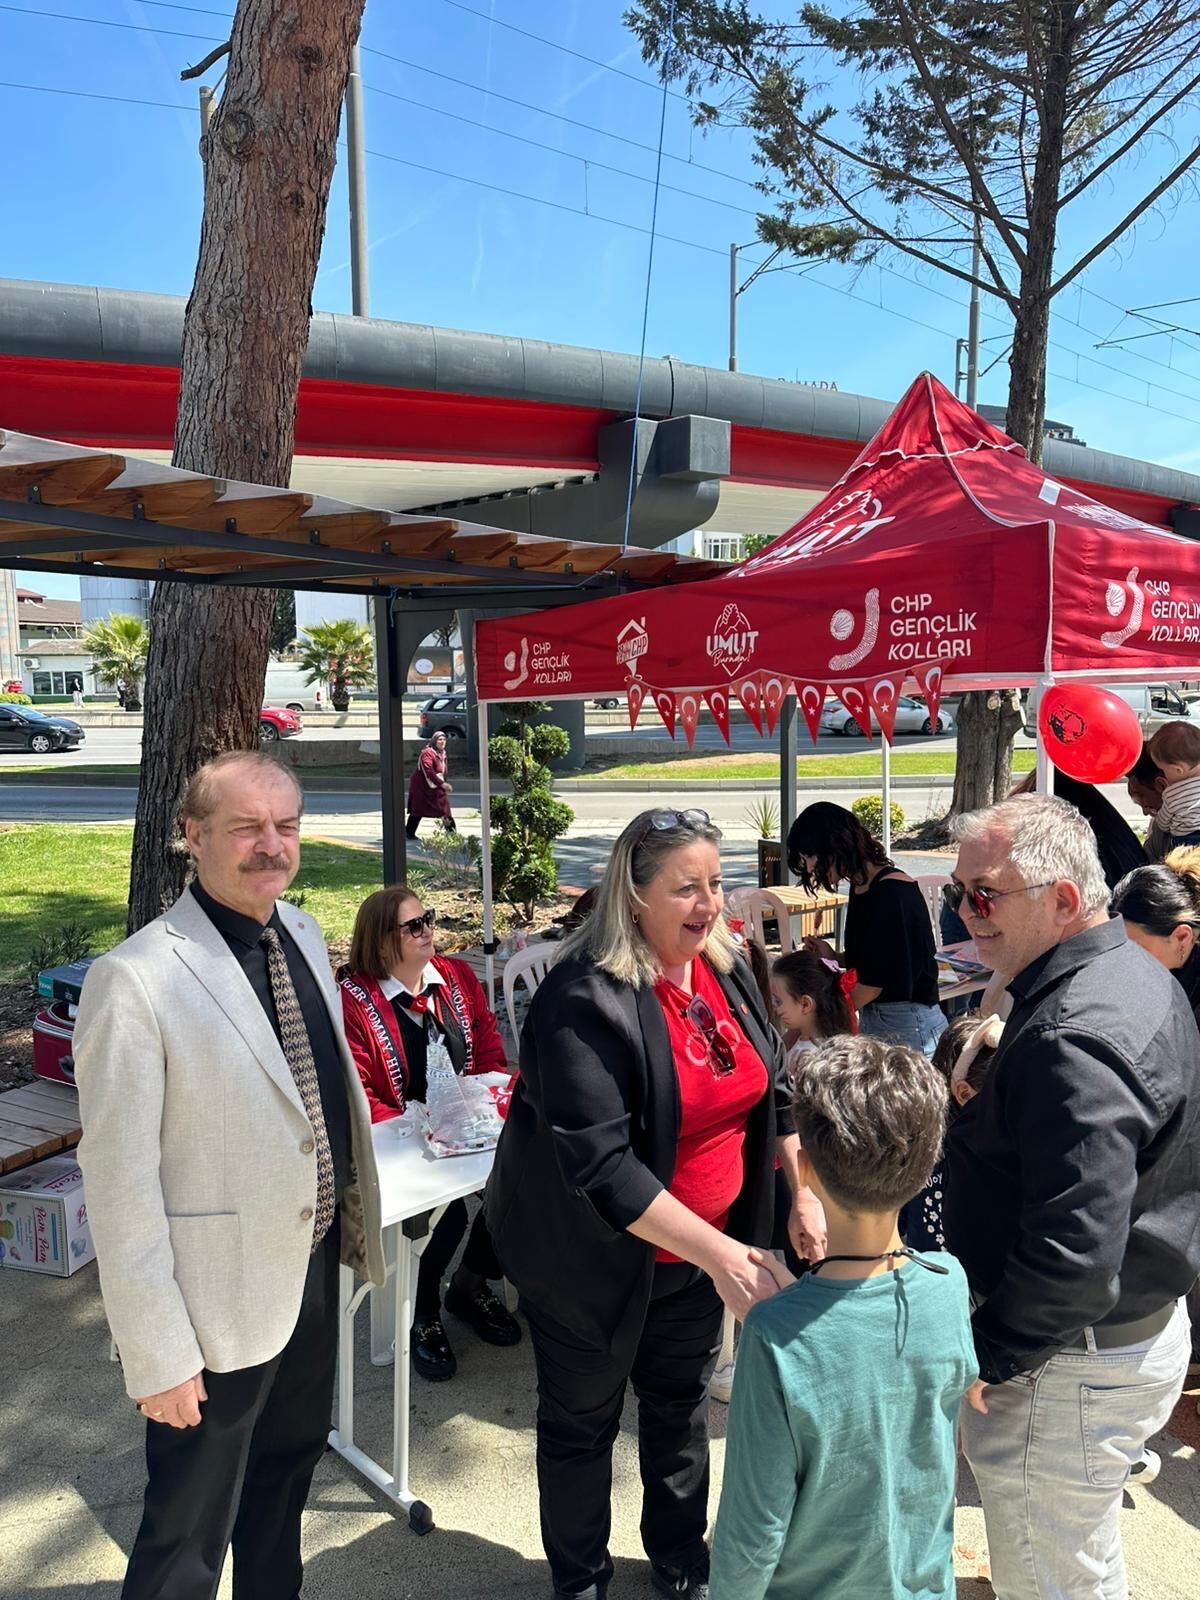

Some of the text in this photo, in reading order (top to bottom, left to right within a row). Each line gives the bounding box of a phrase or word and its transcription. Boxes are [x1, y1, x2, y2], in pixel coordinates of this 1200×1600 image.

[891, 593, 932, 614] CHP
[890, 608, 977, 639] GENÇLİK
[1147, 625, 1200, 642] KOLLAR
[533, 642, 551, 655] CHP
[631, 635, 647, 657] CHP
[706, 631, 759, 656] UMUT
[888, 638, 971, 660] KOLLARI
[531, 652, 570, 671] GENÇLİK
[533, 671, 572, 684] KOLLARI
[365, 1002, 394, 1055] TOMMY
